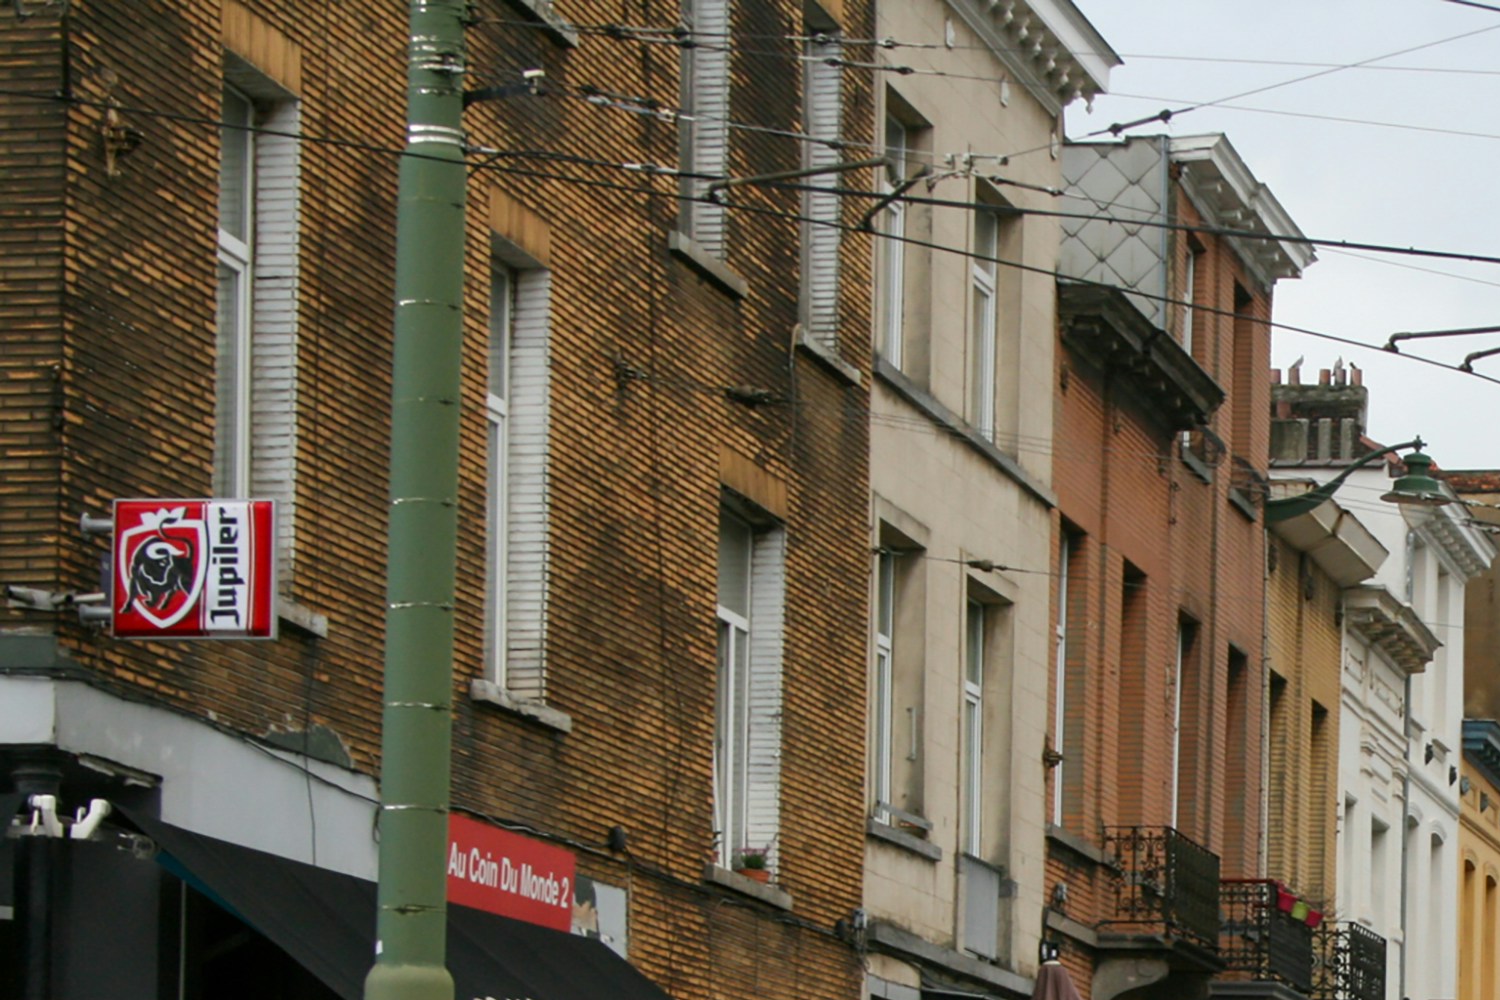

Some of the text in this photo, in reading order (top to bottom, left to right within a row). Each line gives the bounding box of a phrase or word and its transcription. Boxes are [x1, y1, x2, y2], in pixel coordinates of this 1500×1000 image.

[210, 506, 245, 628] Jupiler
[448, 842, 570, 909] Au Coin Du Monde 2
